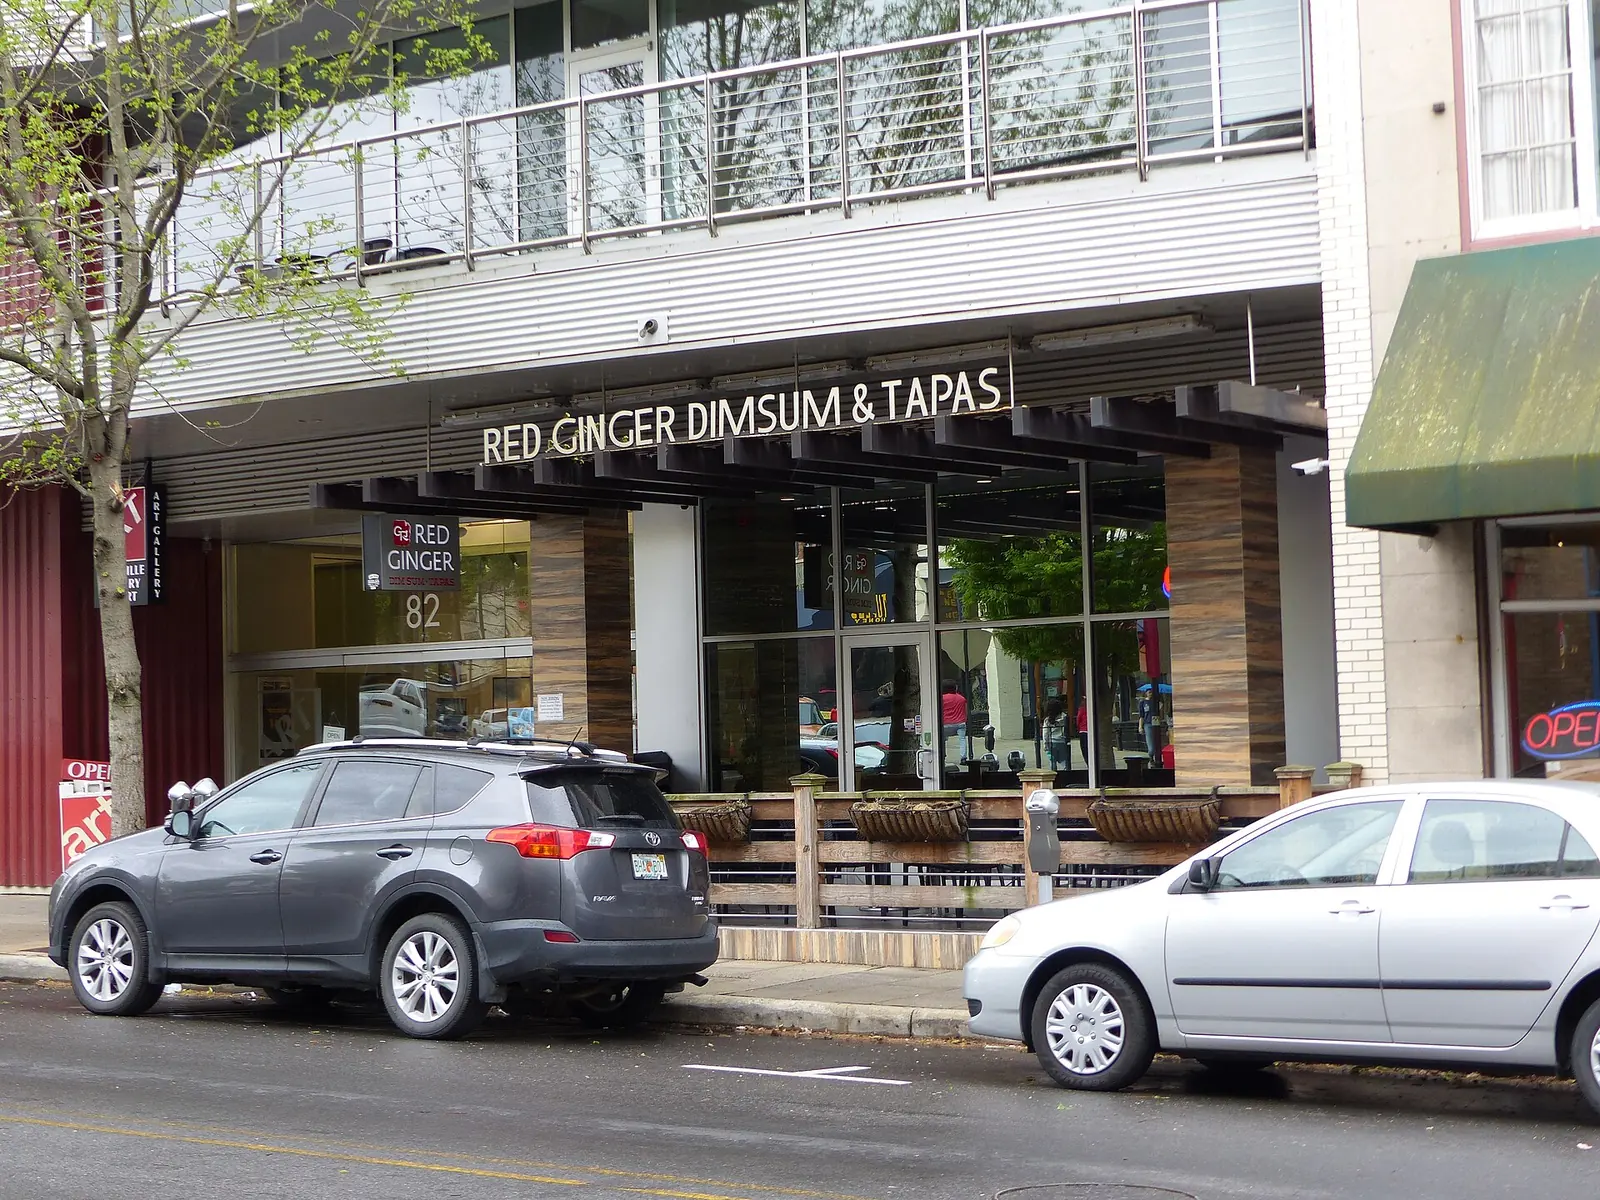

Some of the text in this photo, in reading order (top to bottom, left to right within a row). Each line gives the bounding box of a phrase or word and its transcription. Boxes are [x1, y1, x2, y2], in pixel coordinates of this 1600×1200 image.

[483, 367, 1001, 464] RED GINGER DIMSUM & TAPAS
[415, 524, 450, 545] RED
[153, 526, 161, 598] GALLERY
[388, 550, 455, 572] GINGER
[406, 593, 440, 629] 82
[327, 732, 340, 740] OPEN
[67, 761, 111, 780] OPE
